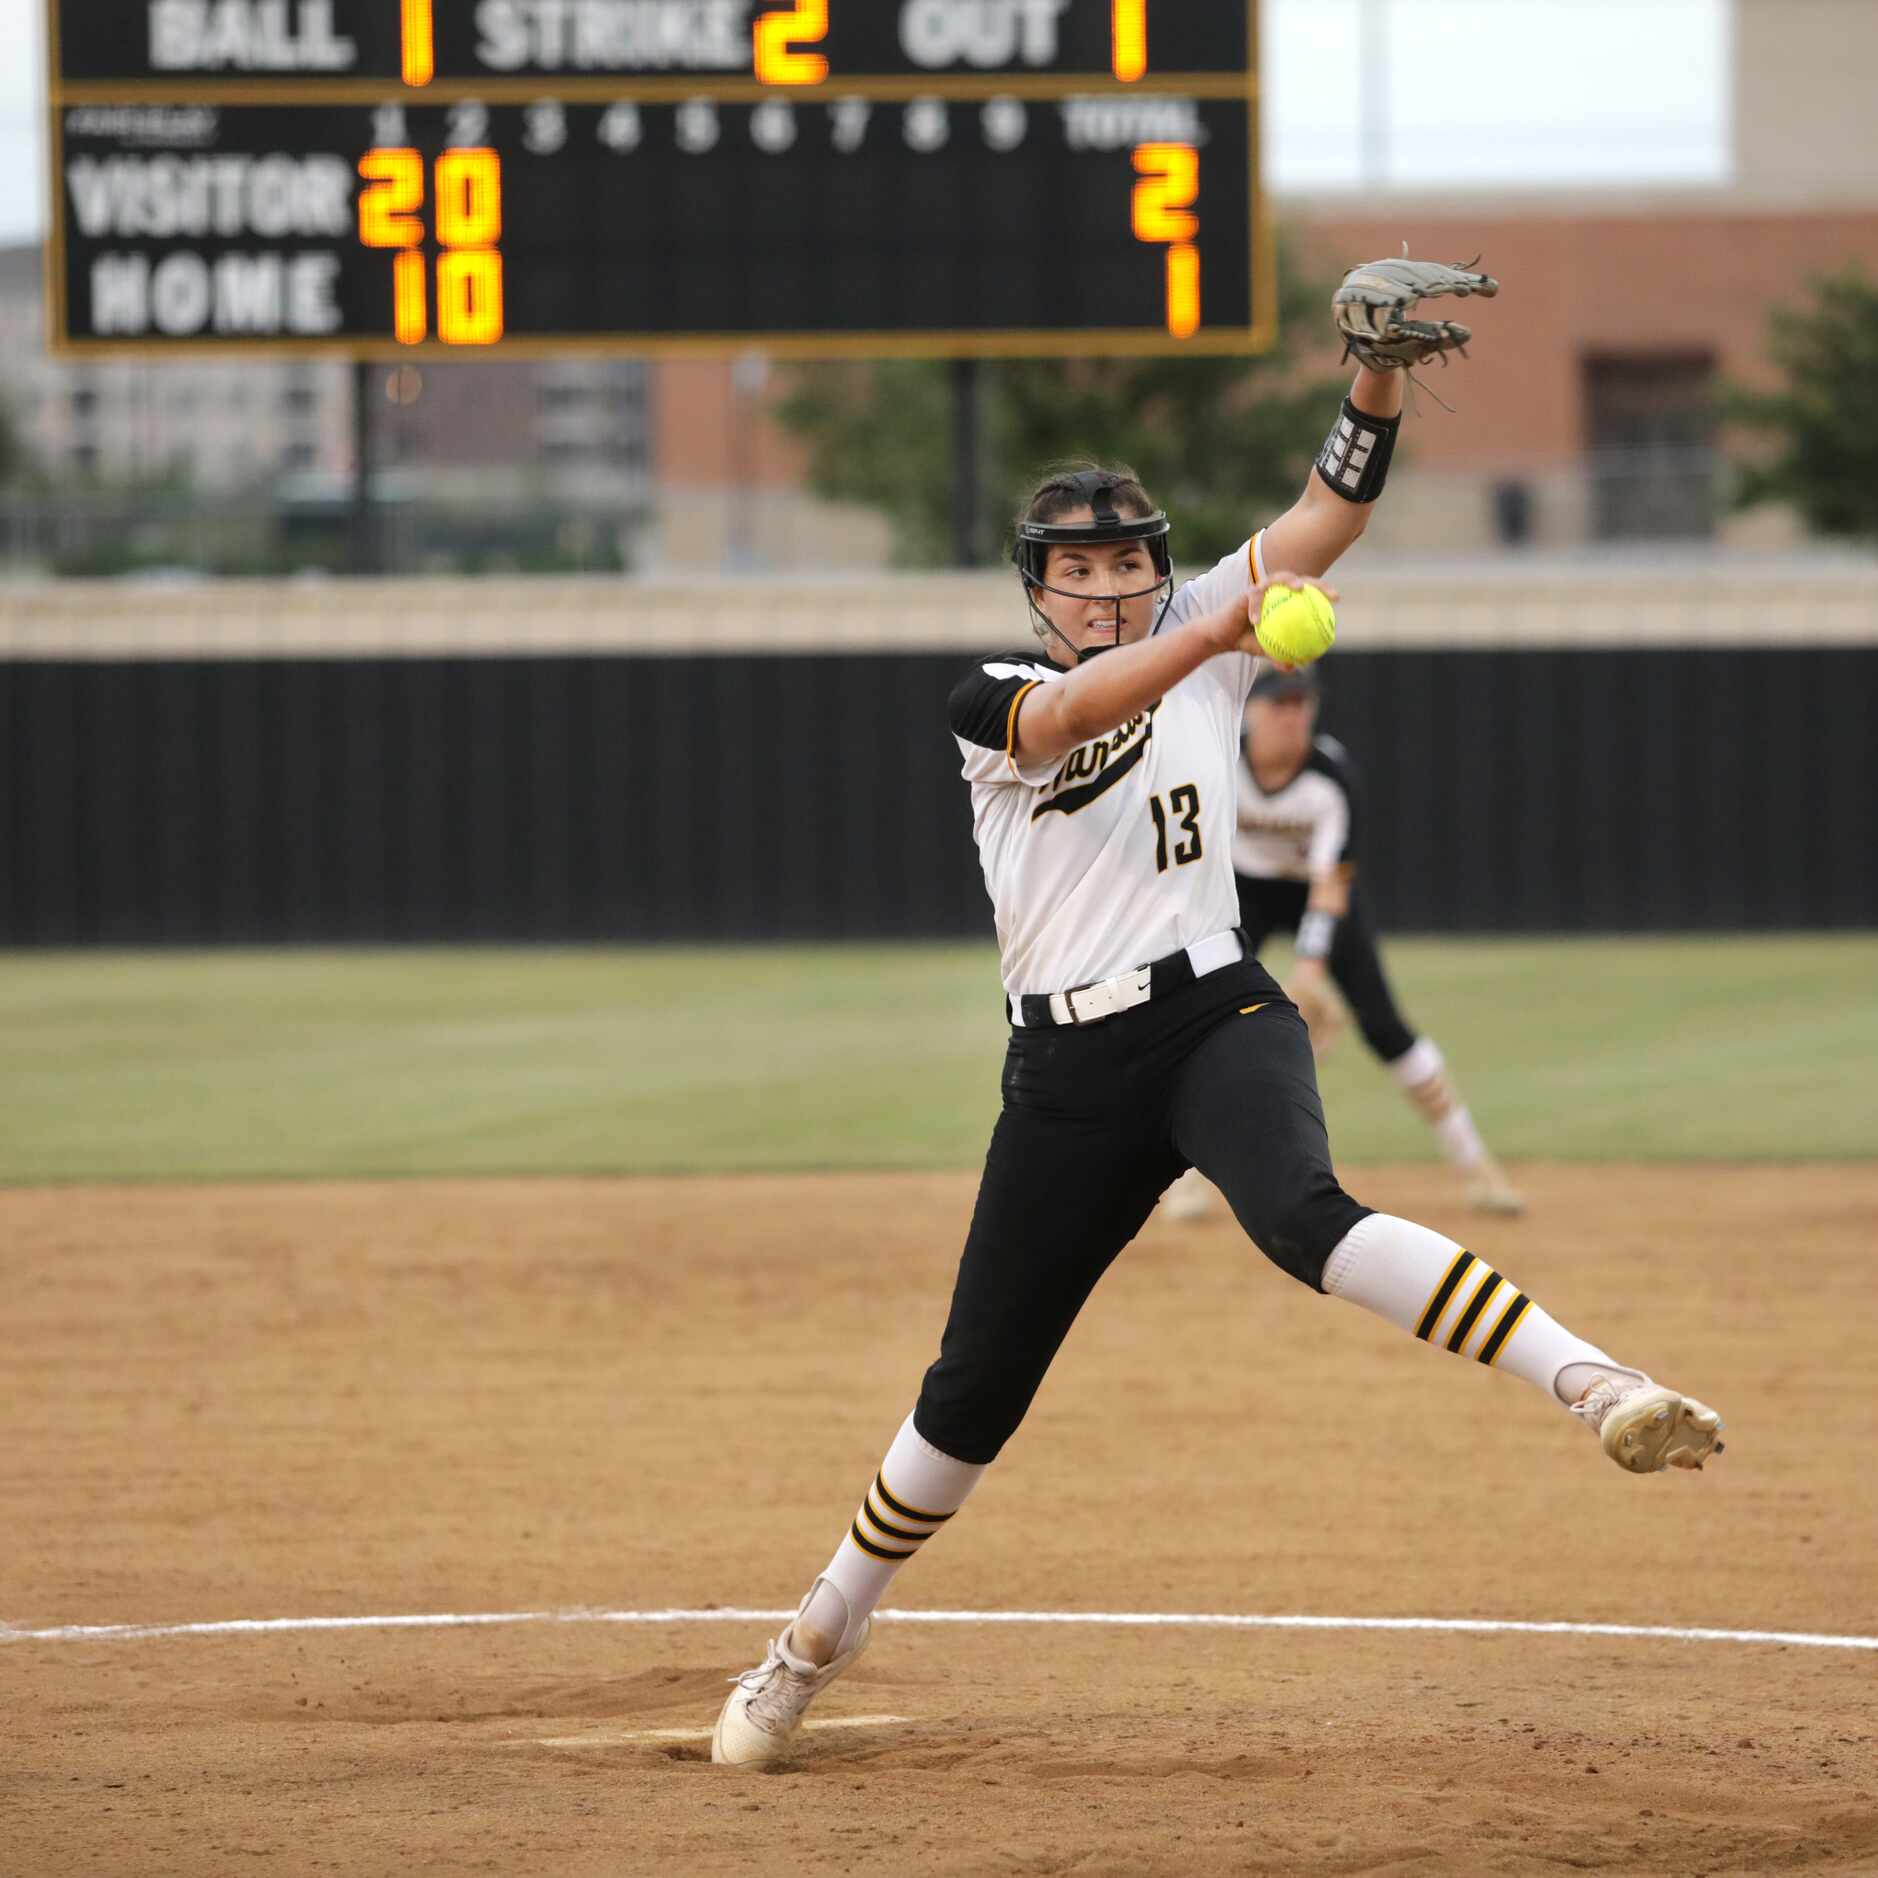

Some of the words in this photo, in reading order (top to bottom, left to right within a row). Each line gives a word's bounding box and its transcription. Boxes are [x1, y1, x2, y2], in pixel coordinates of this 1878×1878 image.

[149, 0, 355, 69] BALL
[402, 0, 433, 86] 1
[476, 0, 752, 69] STRIKE
[754, 0, 828, 84] 2
[900, 0, 1068, 68] OUT
[1111, 0, 1147, 82] 1
[446, 99, 489, 148] 2
[525, 97, 566, 154] 3
[830, 96, 871, 152] 7
[1062, 97, 1205, 149] TOTAL
[67, 152, 353, 236] VISITOR
[358, 147, 424, 249] 2
[434, 147, 501, 248] 0
[1132, 142, 1199, 243] 2
[91, 252, 341, 335] HOME
[393, 247, 427, 345] 1
[436, 248, 503, 345] 0
[1166, 243, 1200, 339] 1
[1149, 784, 1203, 874] 13
